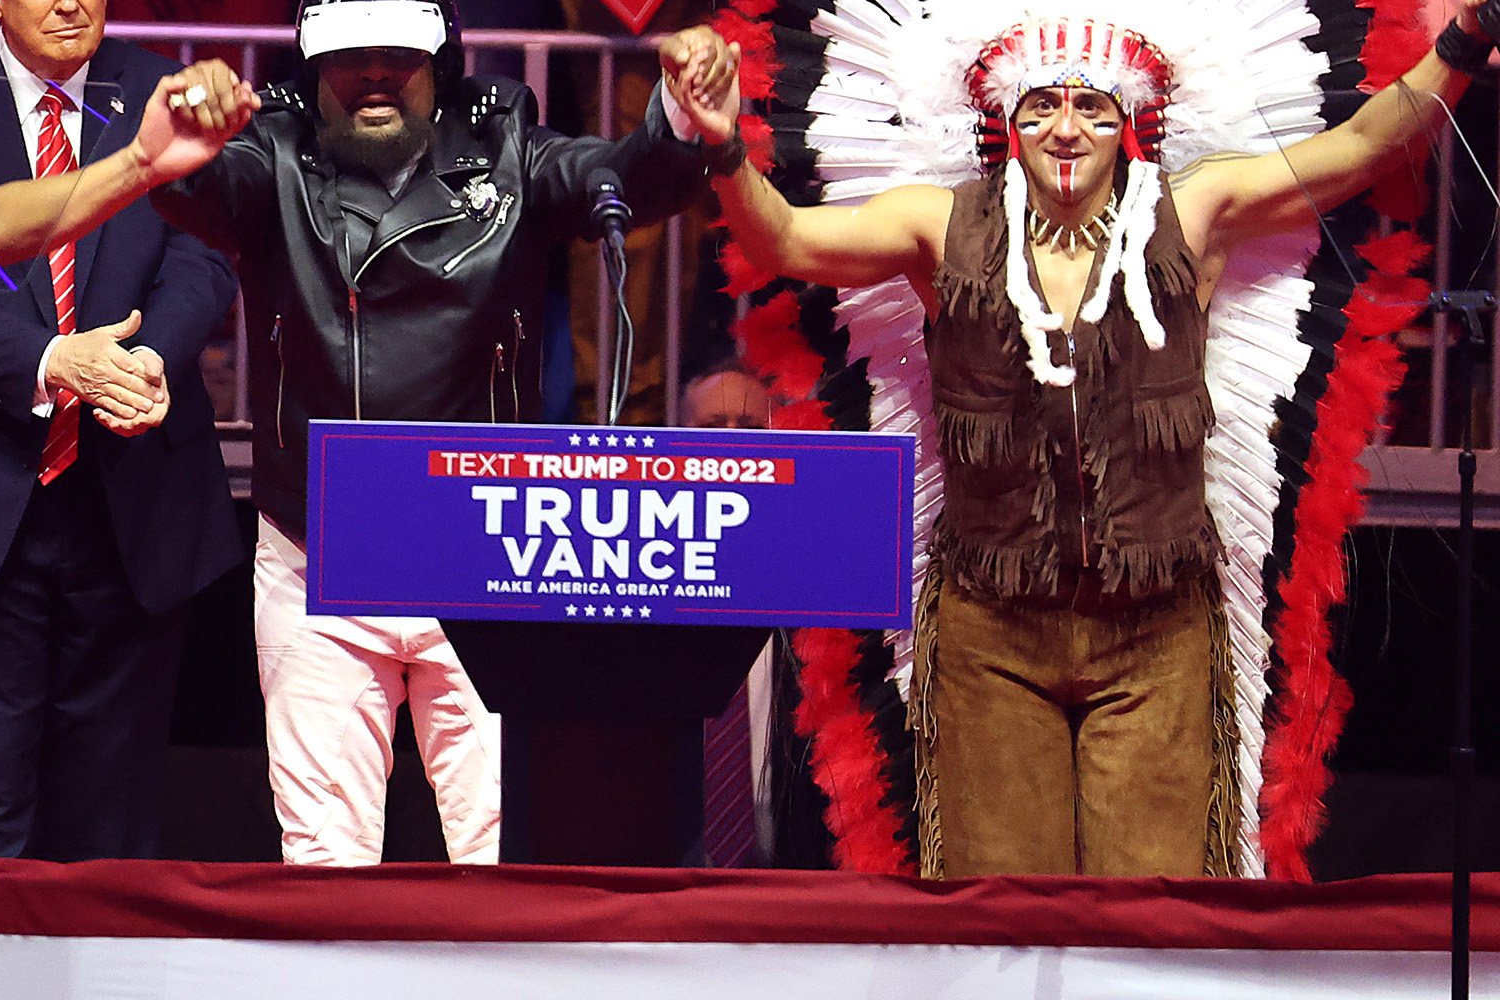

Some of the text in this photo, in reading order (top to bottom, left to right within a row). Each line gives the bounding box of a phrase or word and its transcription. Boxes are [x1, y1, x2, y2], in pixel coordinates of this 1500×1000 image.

[441, 452, 776, 483] TEXT TRUMP TO 88022
[471, 485, 750, 540] TRUMP
[501, 536, 717, 581] VANCE
[486, 579, 731, 599] MAKE AMERICA GREAT AGAIN!
